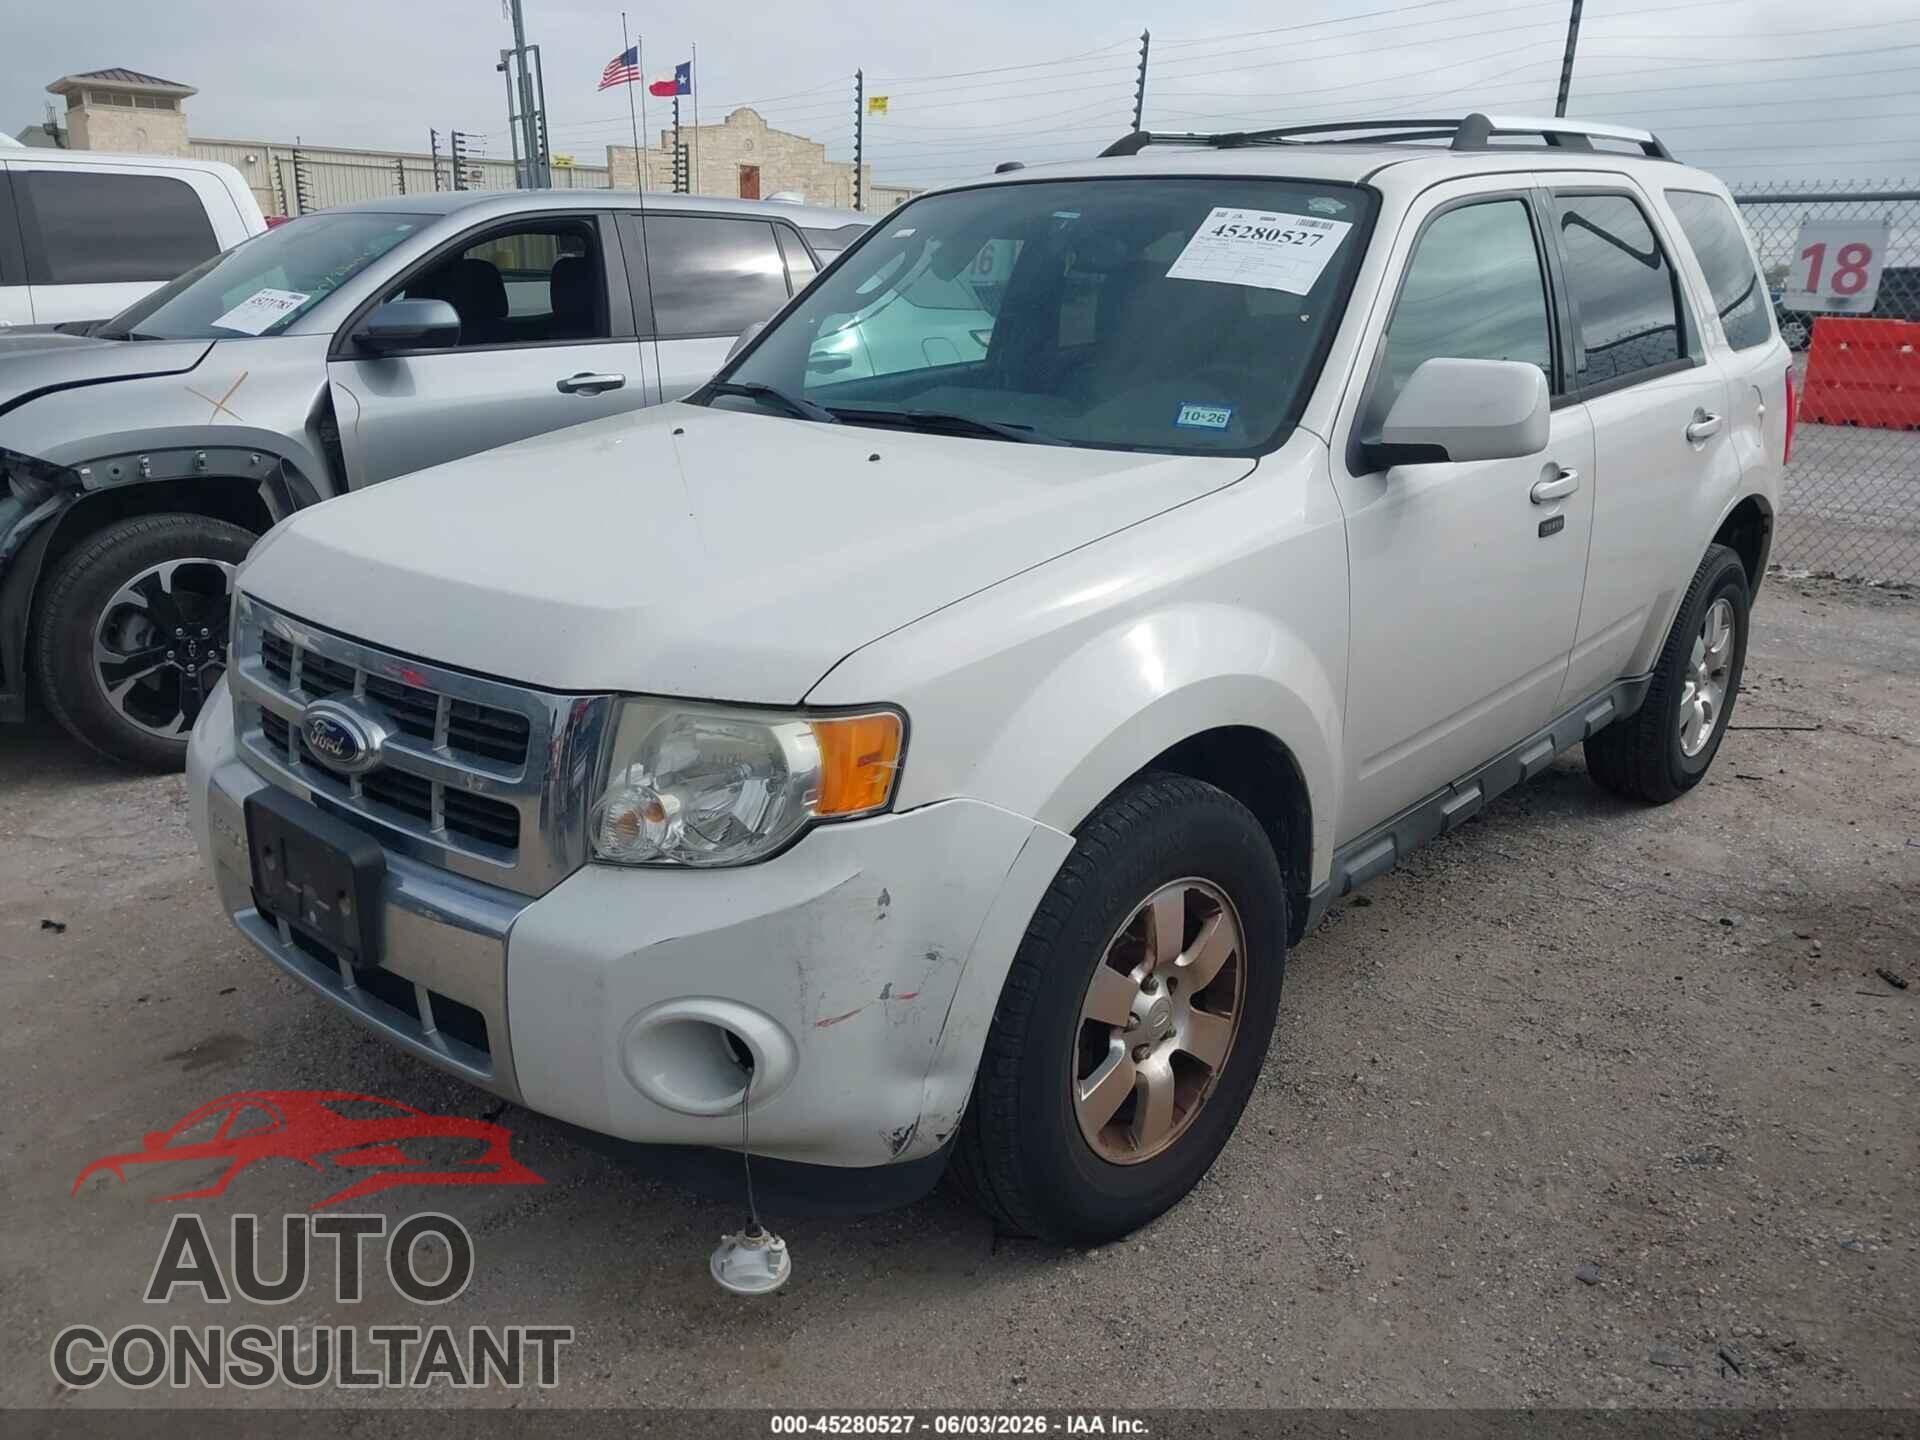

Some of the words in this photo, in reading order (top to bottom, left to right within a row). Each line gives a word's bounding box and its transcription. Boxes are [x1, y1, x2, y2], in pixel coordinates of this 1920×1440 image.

[1211, 223, 1324, 248] 45280527
[1801, 242, 1873, 296] 18
[310, 719, 344, 755] Ford
